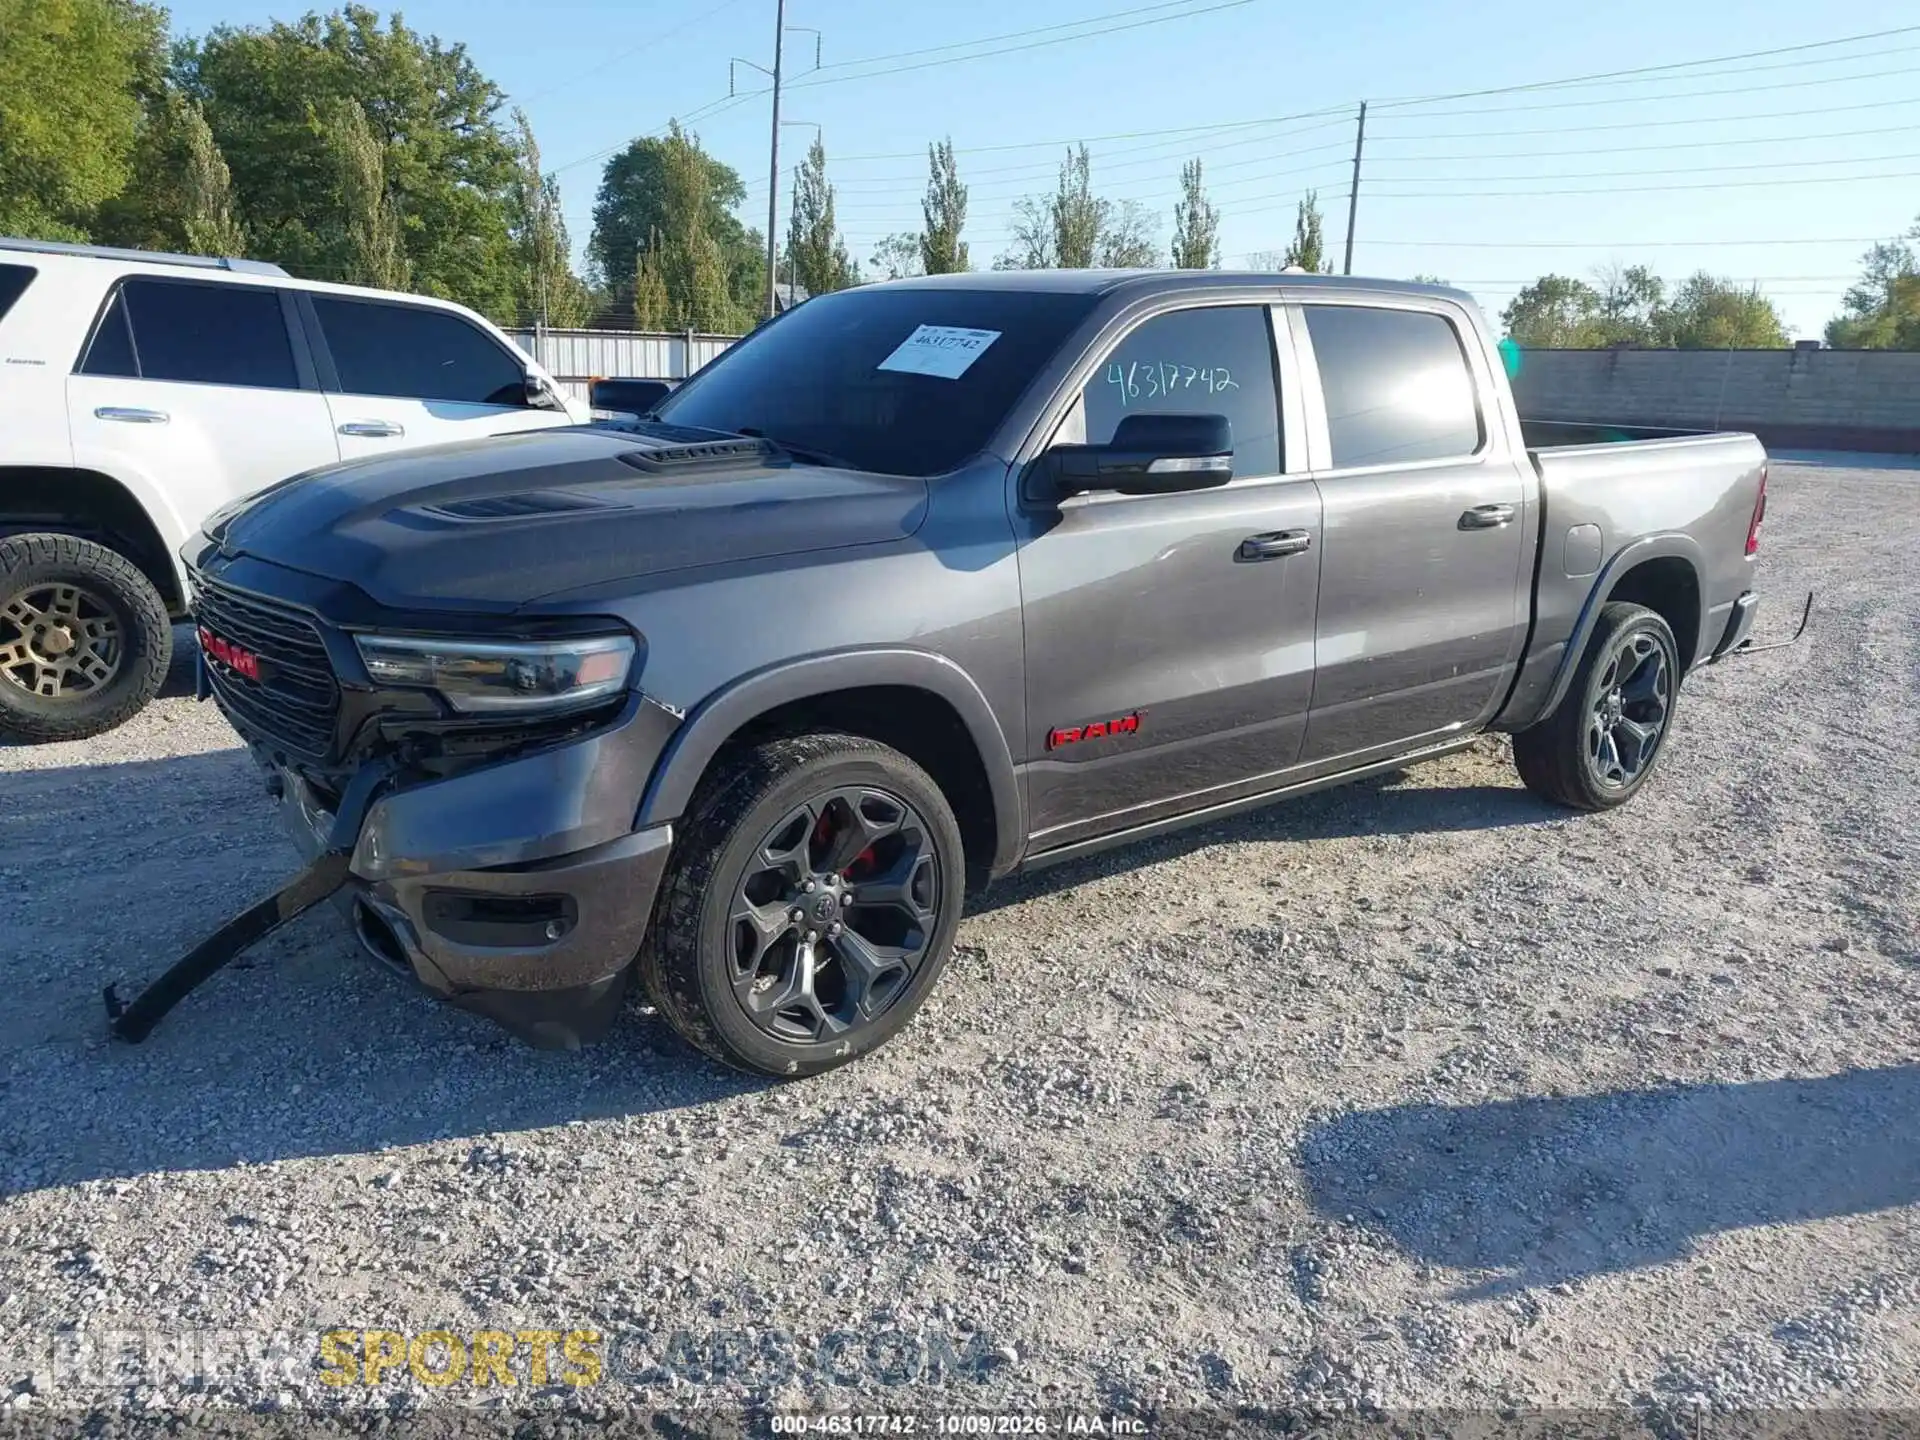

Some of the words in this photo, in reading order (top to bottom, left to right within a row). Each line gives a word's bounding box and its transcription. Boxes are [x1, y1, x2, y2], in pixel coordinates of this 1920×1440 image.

[1107, 360, 1240, 407] 46317742
[199, 625, 259, 681] RAM
[1051, 715, 1138, 749] RAM
